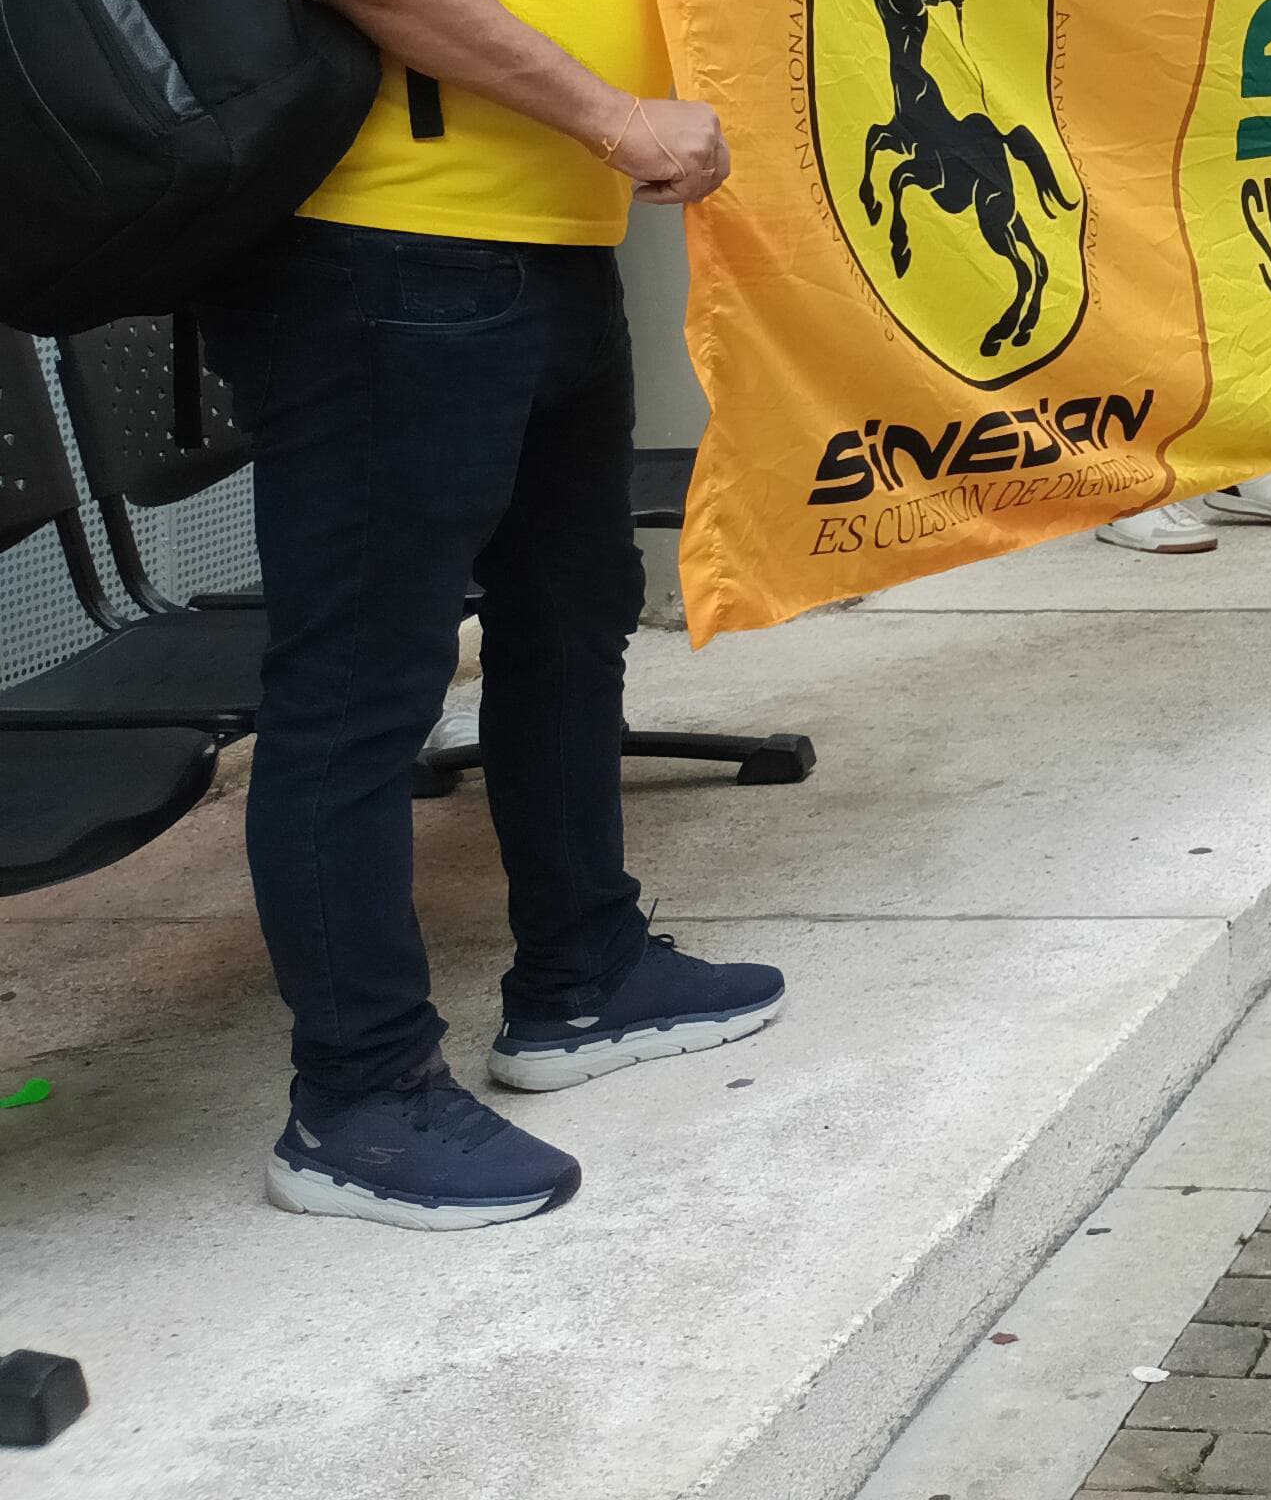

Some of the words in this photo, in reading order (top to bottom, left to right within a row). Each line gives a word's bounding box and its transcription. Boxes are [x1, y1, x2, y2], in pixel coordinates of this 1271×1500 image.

[810, 513, 867, 557] ES
[872, 475, 996, 549] CUESTIÓN
[991, 476, 1048, 513] DE
[1040, 453, 1155, 503] DIGNIDAD
